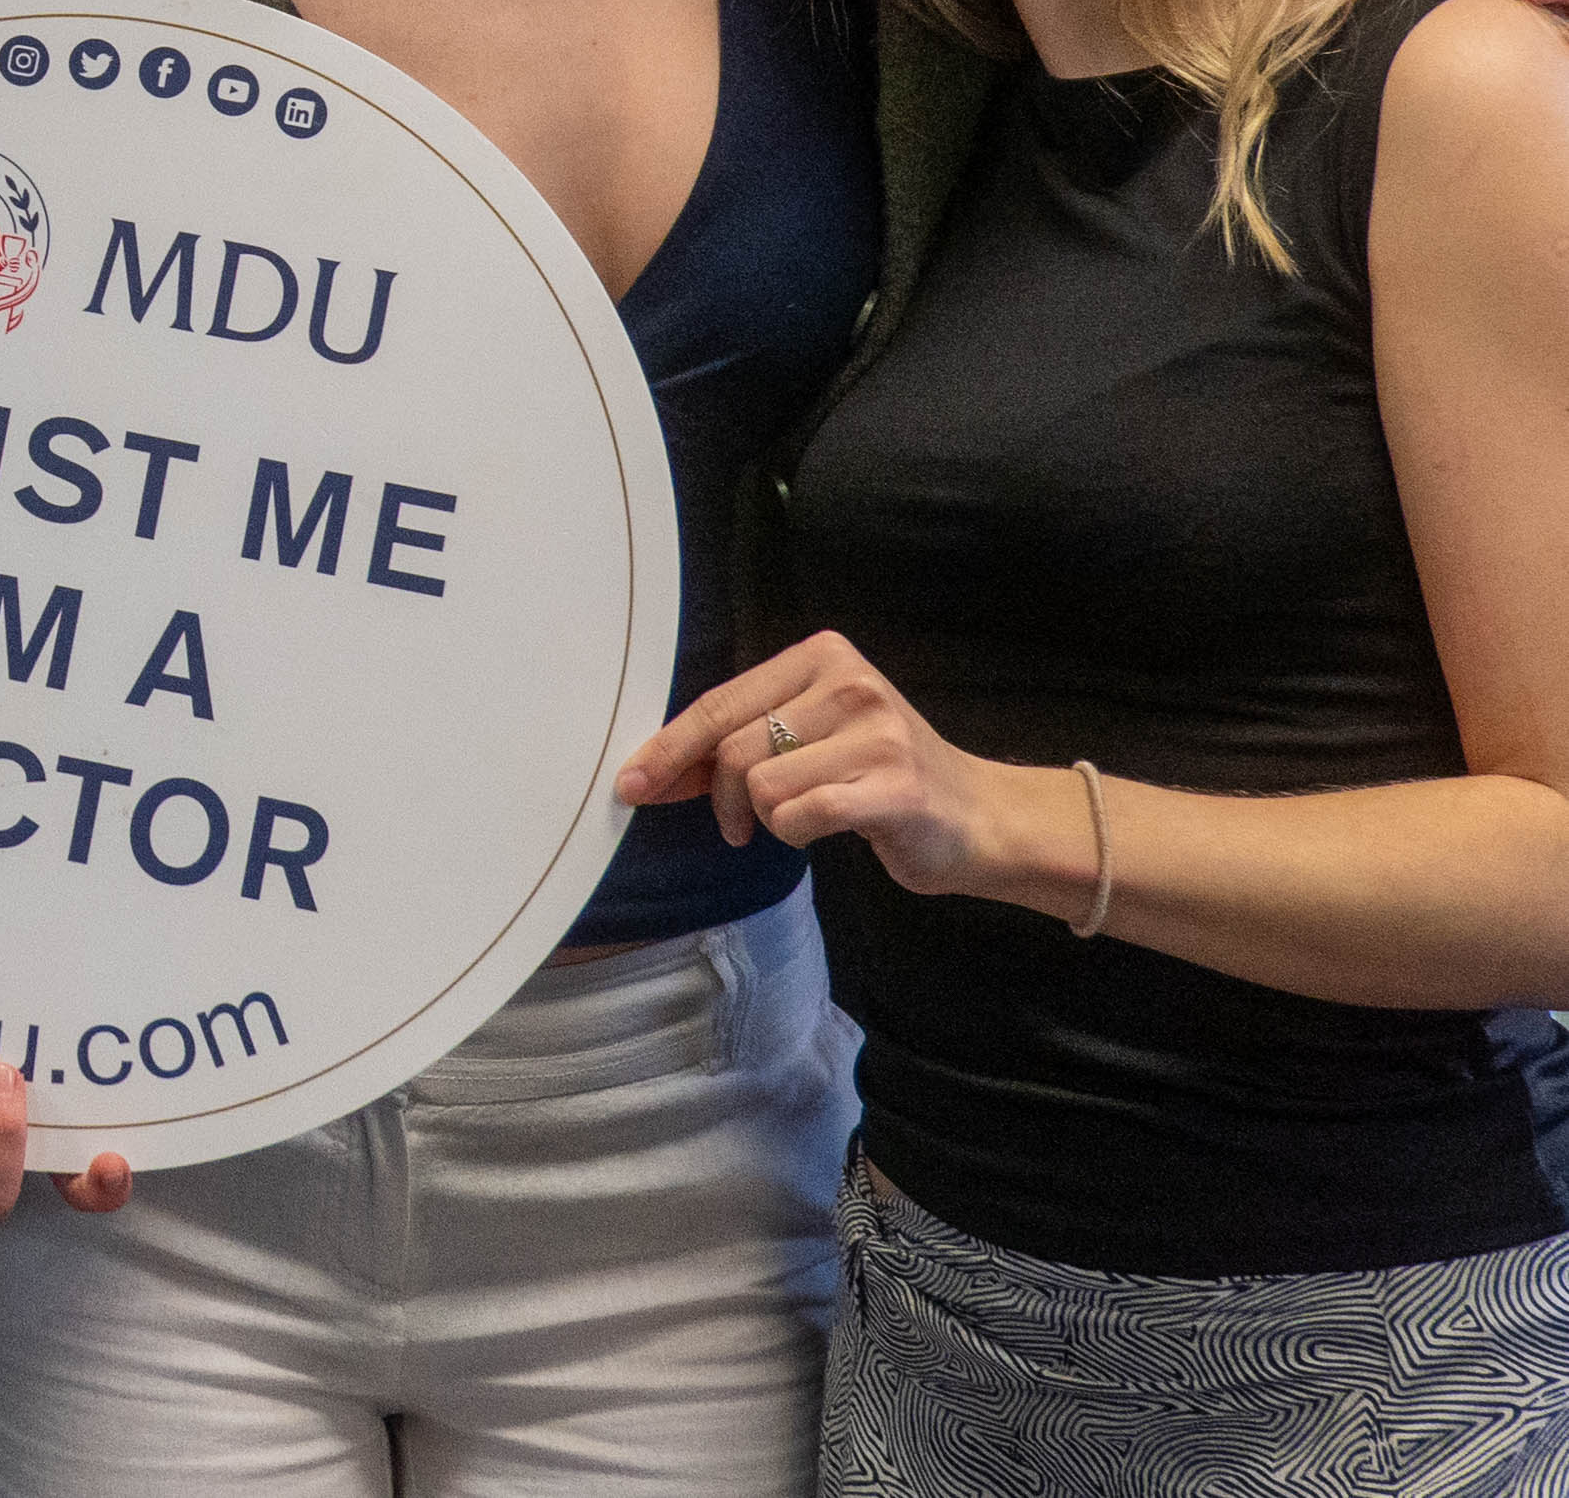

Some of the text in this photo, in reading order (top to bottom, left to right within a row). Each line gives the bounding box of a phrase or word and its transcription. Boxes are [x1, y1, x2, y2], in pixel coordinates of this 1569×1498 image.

[83, 218, 398, 365] MDU
[240, 457, 458, 598] ME
[124, 609, 215, 721] A
